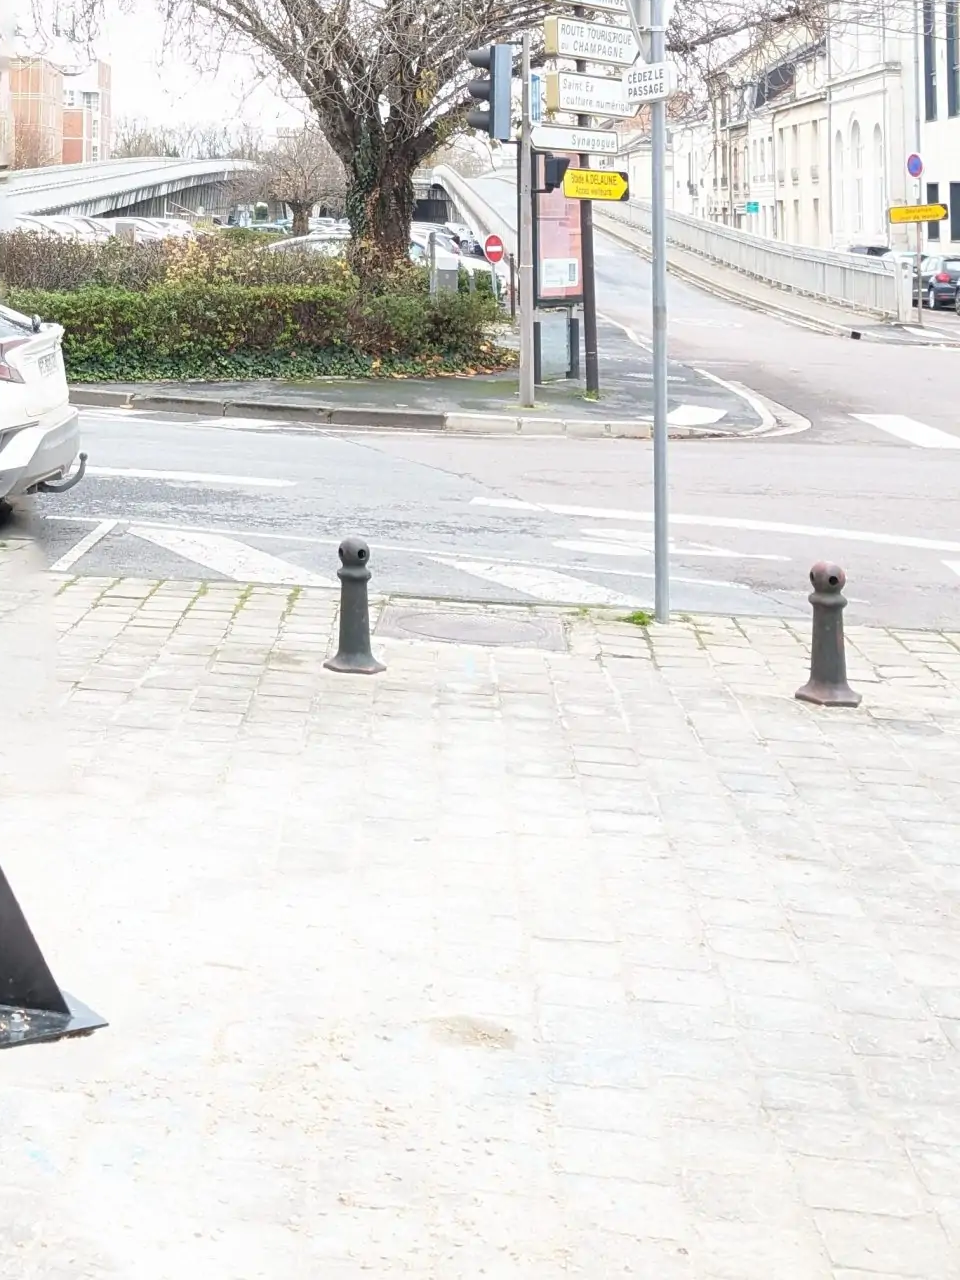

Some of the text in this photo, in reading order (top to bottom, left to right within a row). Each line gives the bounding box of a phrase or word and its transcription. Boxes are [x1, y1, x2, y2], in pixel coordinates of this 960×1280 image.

[561, 24, 632, 45] ROUTE TOURISTIQUE
[573, 40, 623, 58] CHAMPAGNE
[628, 68, 664, 85] CÉDEZ LE
[628, 82, 664, 98] PASSAGE
[572, 134, 615, 149] Synagogue
